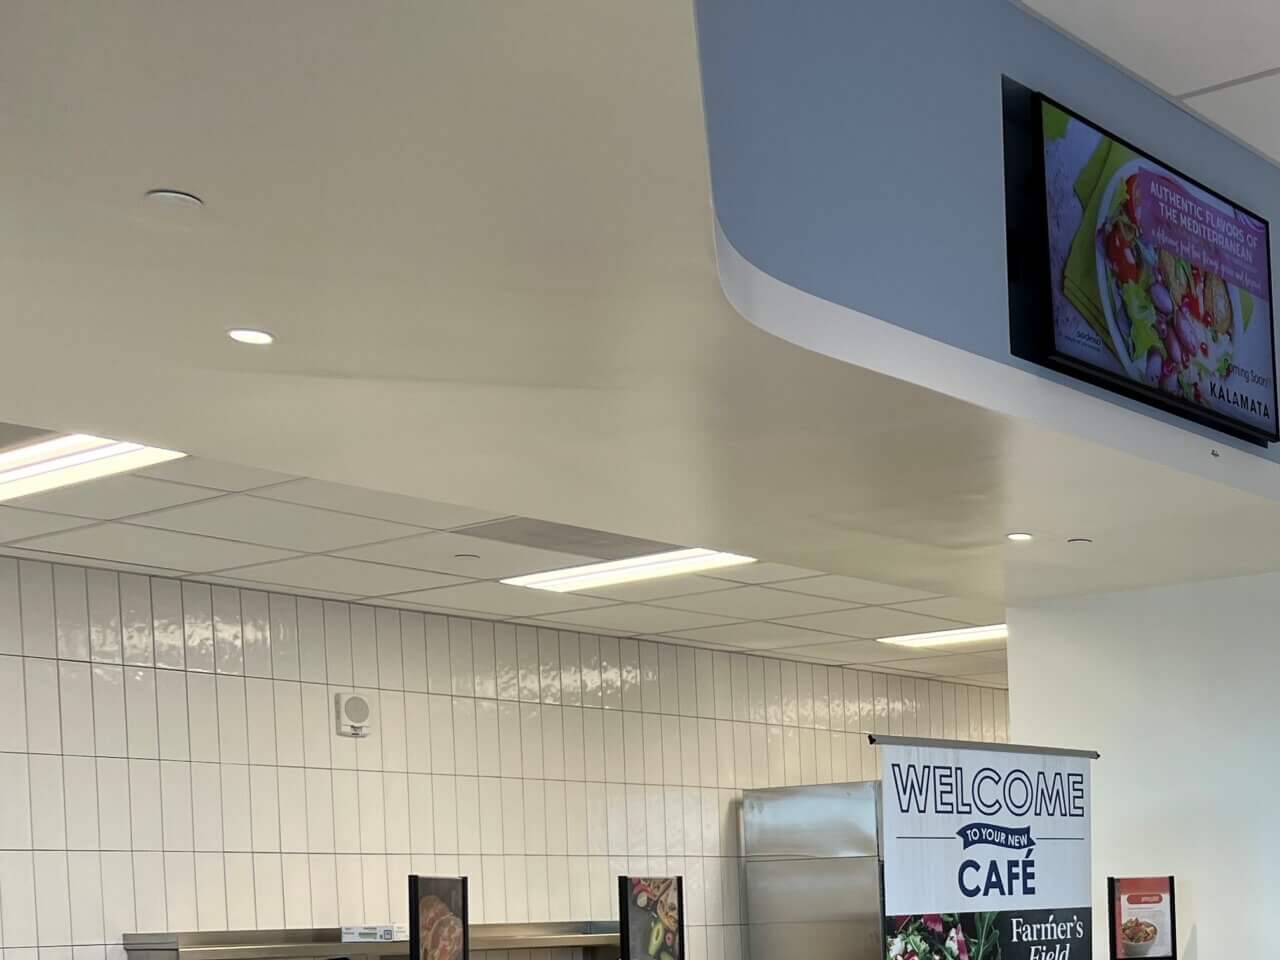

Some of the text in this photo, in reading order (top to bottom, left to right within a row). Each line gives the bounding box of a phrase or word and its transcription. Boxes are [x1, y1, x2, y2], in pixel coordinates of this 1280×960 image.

[1150, 181, 1203, 221] AUTHENTIC
[1205, 210, 1245, 241] FLAVORS
[1246, 234, 1258, 248] OF
[1159, 202, 1178, 224] THE
[1180, 214, 1253, 263] MEDITERRANEAN
[1209, 380, 1270, 419] KALAMATA
[891, 763, 1085, 817] WELCOME
[966, 828, 1028, 847] TO YOUR NEW
[958, 848, 1036, 898] CAFÉ
[1010, 914, 1084, 942] Farmer's
